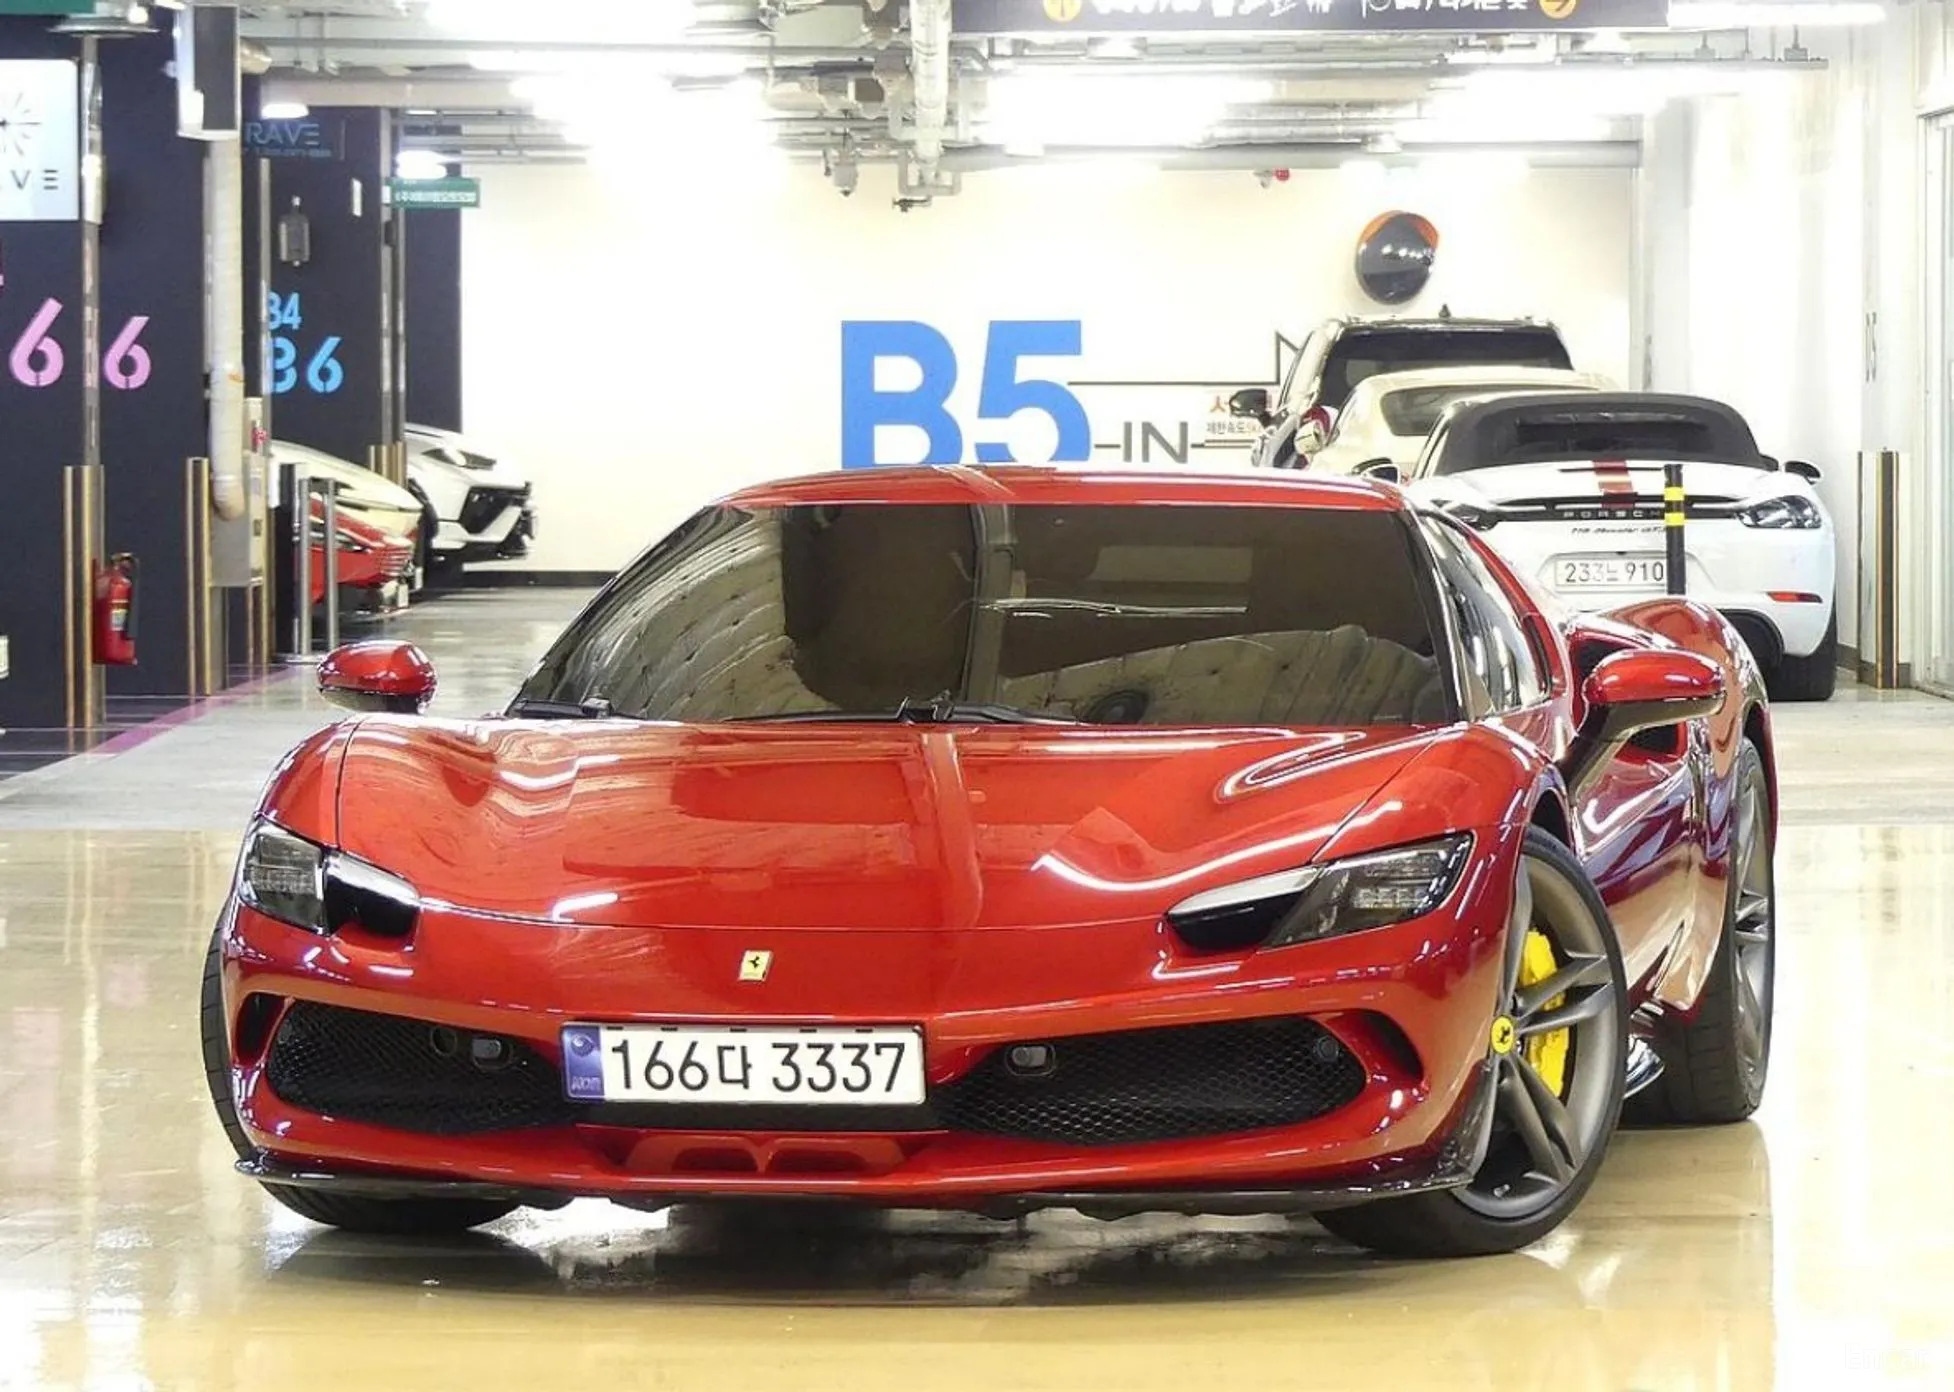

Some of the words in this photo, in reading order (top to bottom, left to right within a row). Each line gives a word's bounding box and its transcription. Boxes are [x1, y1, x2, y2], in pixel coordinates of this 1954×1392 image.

[246, 121, 321, 145] RAVE
[0, 169, 59, 191] VE
[841, 320, 1091, 467] B5
[1124, 422, 1189, 464] IN
[1563, 510, 1660, 518] PORSCH
[1625, 561, 1665, 583] 910
[611, 1039, 752, 1091] 166다
[771, 1041, 906, 1093] 3337
